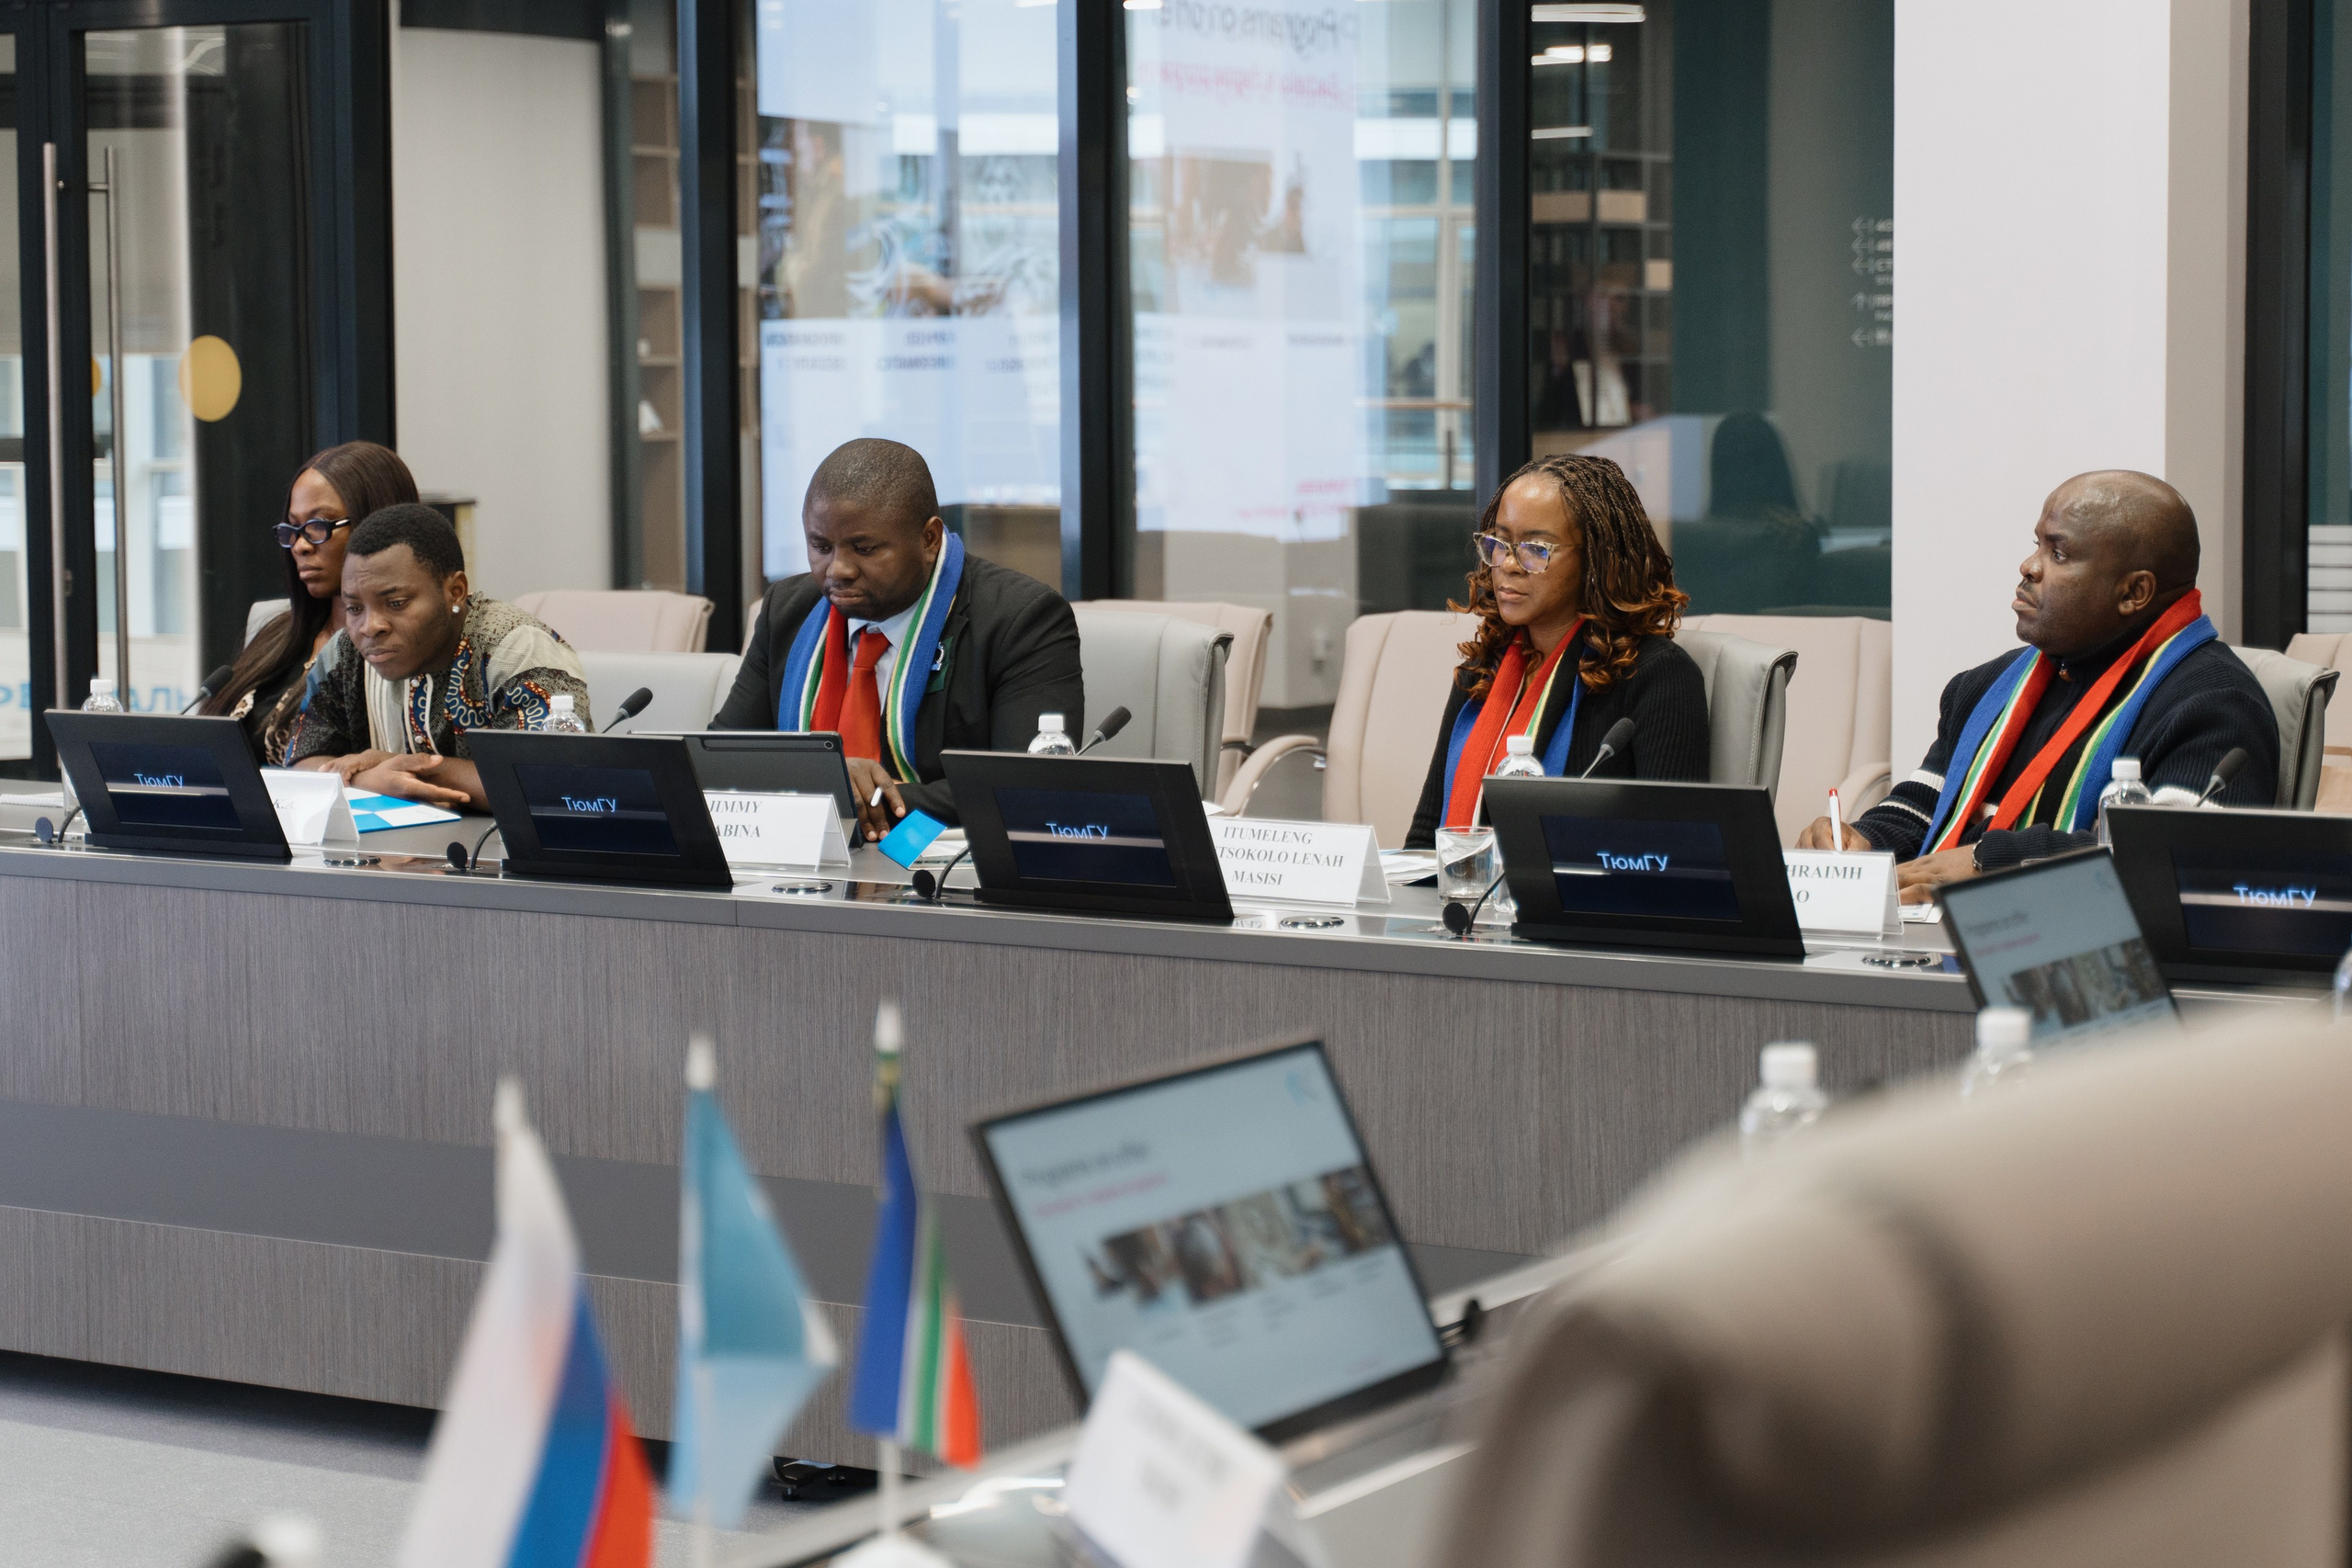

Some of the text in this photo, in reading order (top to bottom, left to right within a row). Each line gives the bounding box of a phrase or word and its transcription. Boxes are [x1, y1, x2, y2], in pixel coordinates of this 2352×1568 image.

[133, 773, 183, 789] ТюмГУ
[560, 796, 616, 813] ТюмГУ
[709, 800, 763, 814] JIMMY
[1045, 823, 1108, 840] ТюмГУ
[1223, 827, 1314, 845] ITUMELENG
[1215, 845, 1344, 868] TSOKOLO LENAH
[1596, 852, 1668, 872] ТюмГУ
[1231, 870, 1283, 886] MASISI
[2233, 886, 2316, 908] ТюмГУ
